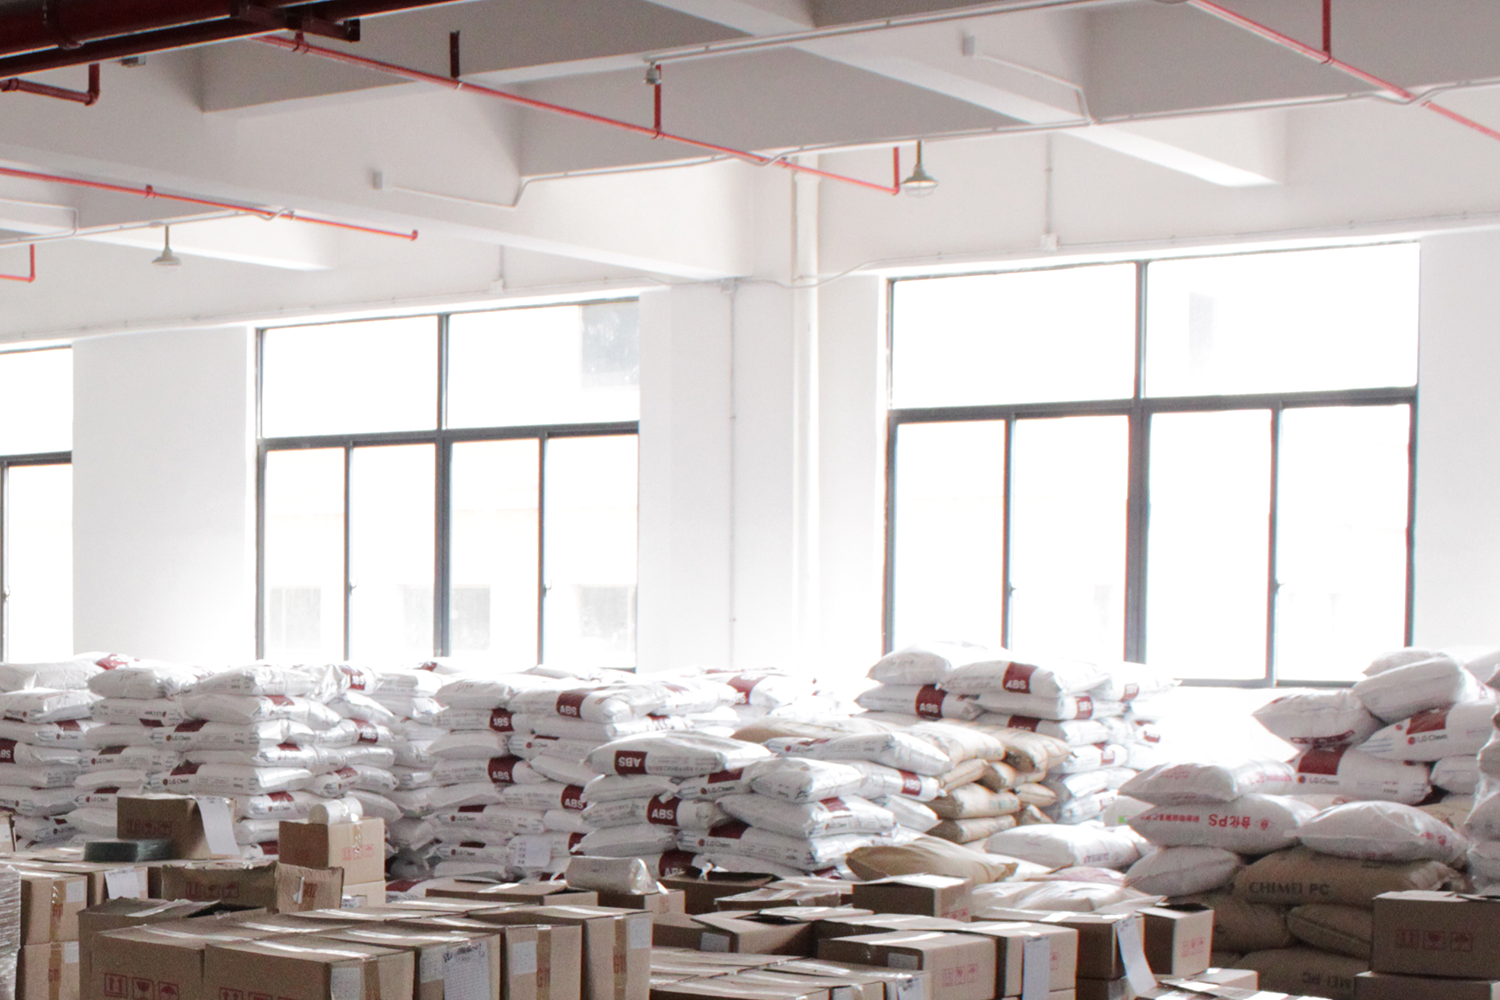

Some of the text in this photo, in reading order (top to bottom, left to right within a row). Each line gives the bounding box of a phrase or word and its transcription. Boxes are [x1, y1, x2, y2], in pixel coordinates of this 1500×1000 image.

[1006, 680, 1027, 690] ABS
[560, 705, 577, 715] ABS
[919, 703, 939, 713] ABS
[493, 718, 508, 727] ABS
[1417, 735, 1428, 743] LG
[618, 757, 642, 767] ABS
[492, 771, 509, 780] ABS
[565, 800, 583, 809] ABS
[652, 809, 674, 820] ABS
[1251, 882, 1329, 895] CHIMEI PC
